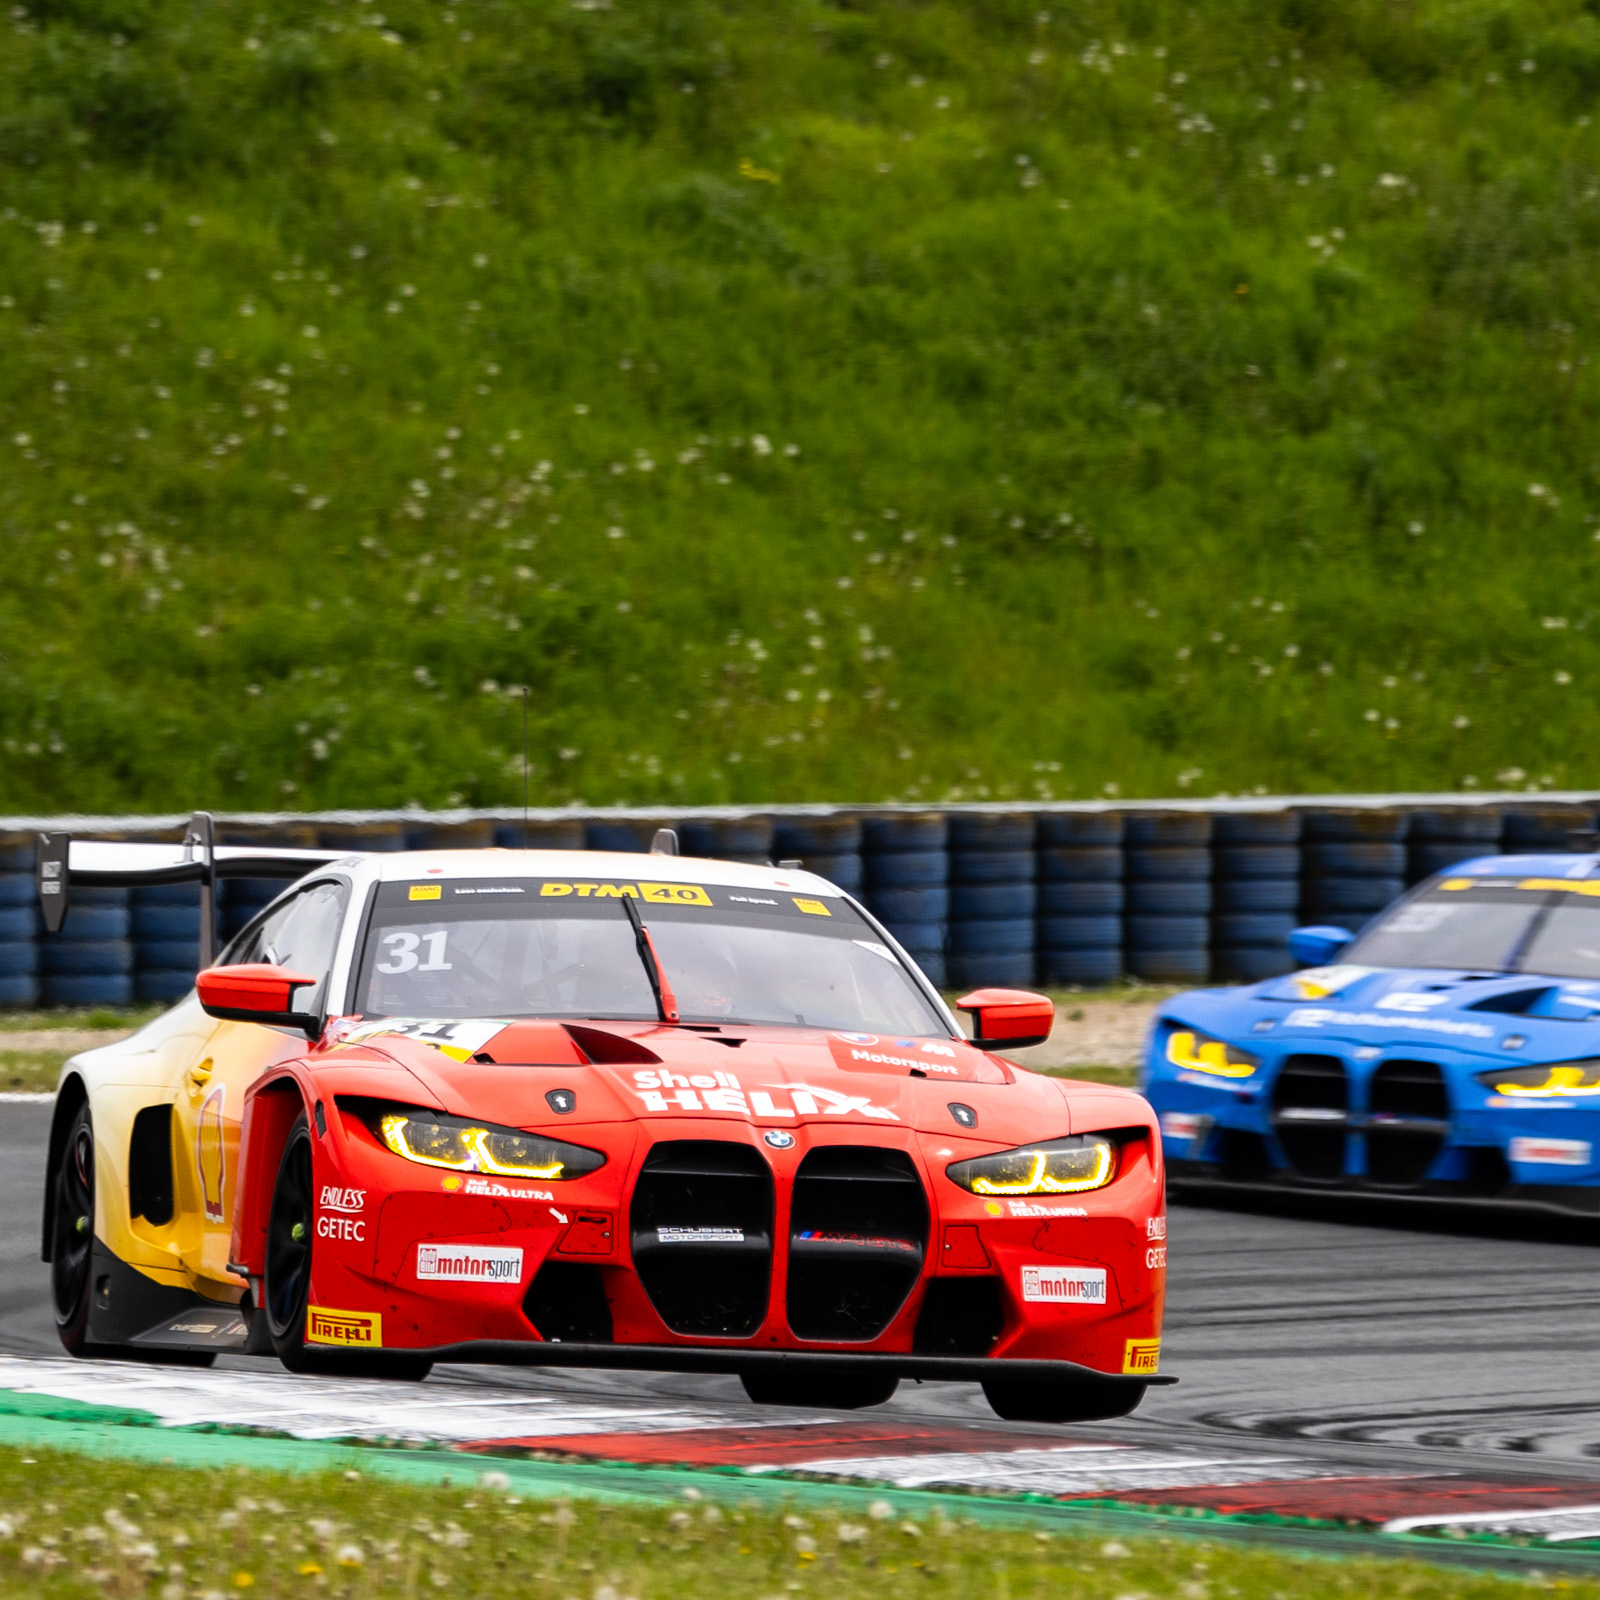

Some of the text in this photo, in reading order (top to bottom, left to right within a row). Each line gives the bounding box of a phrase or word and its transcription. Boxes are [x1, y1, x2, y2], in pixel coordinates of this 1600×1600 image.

[540, 883, 639, 899] DTM
[651, 888, 699, 901] 40
[376, 930, 453, 975] 31
[851, 1049, 959, 1075] Motorsport
[633, 1069, 741, 1090] Shell
[636, 1082, 901, 1121] HELIX
[319, 1186, 368, 1209] ENDLESS
[465, 1184, 554, 1201] HELIX ULTRA
[317, 1216, 366, 1242] GETEC
[437, 1255, 520, 1279] motorsport
[1040, 1277, 1104, 1300] motorsport
[311, 1312, 373, 1342] PIRELLI
